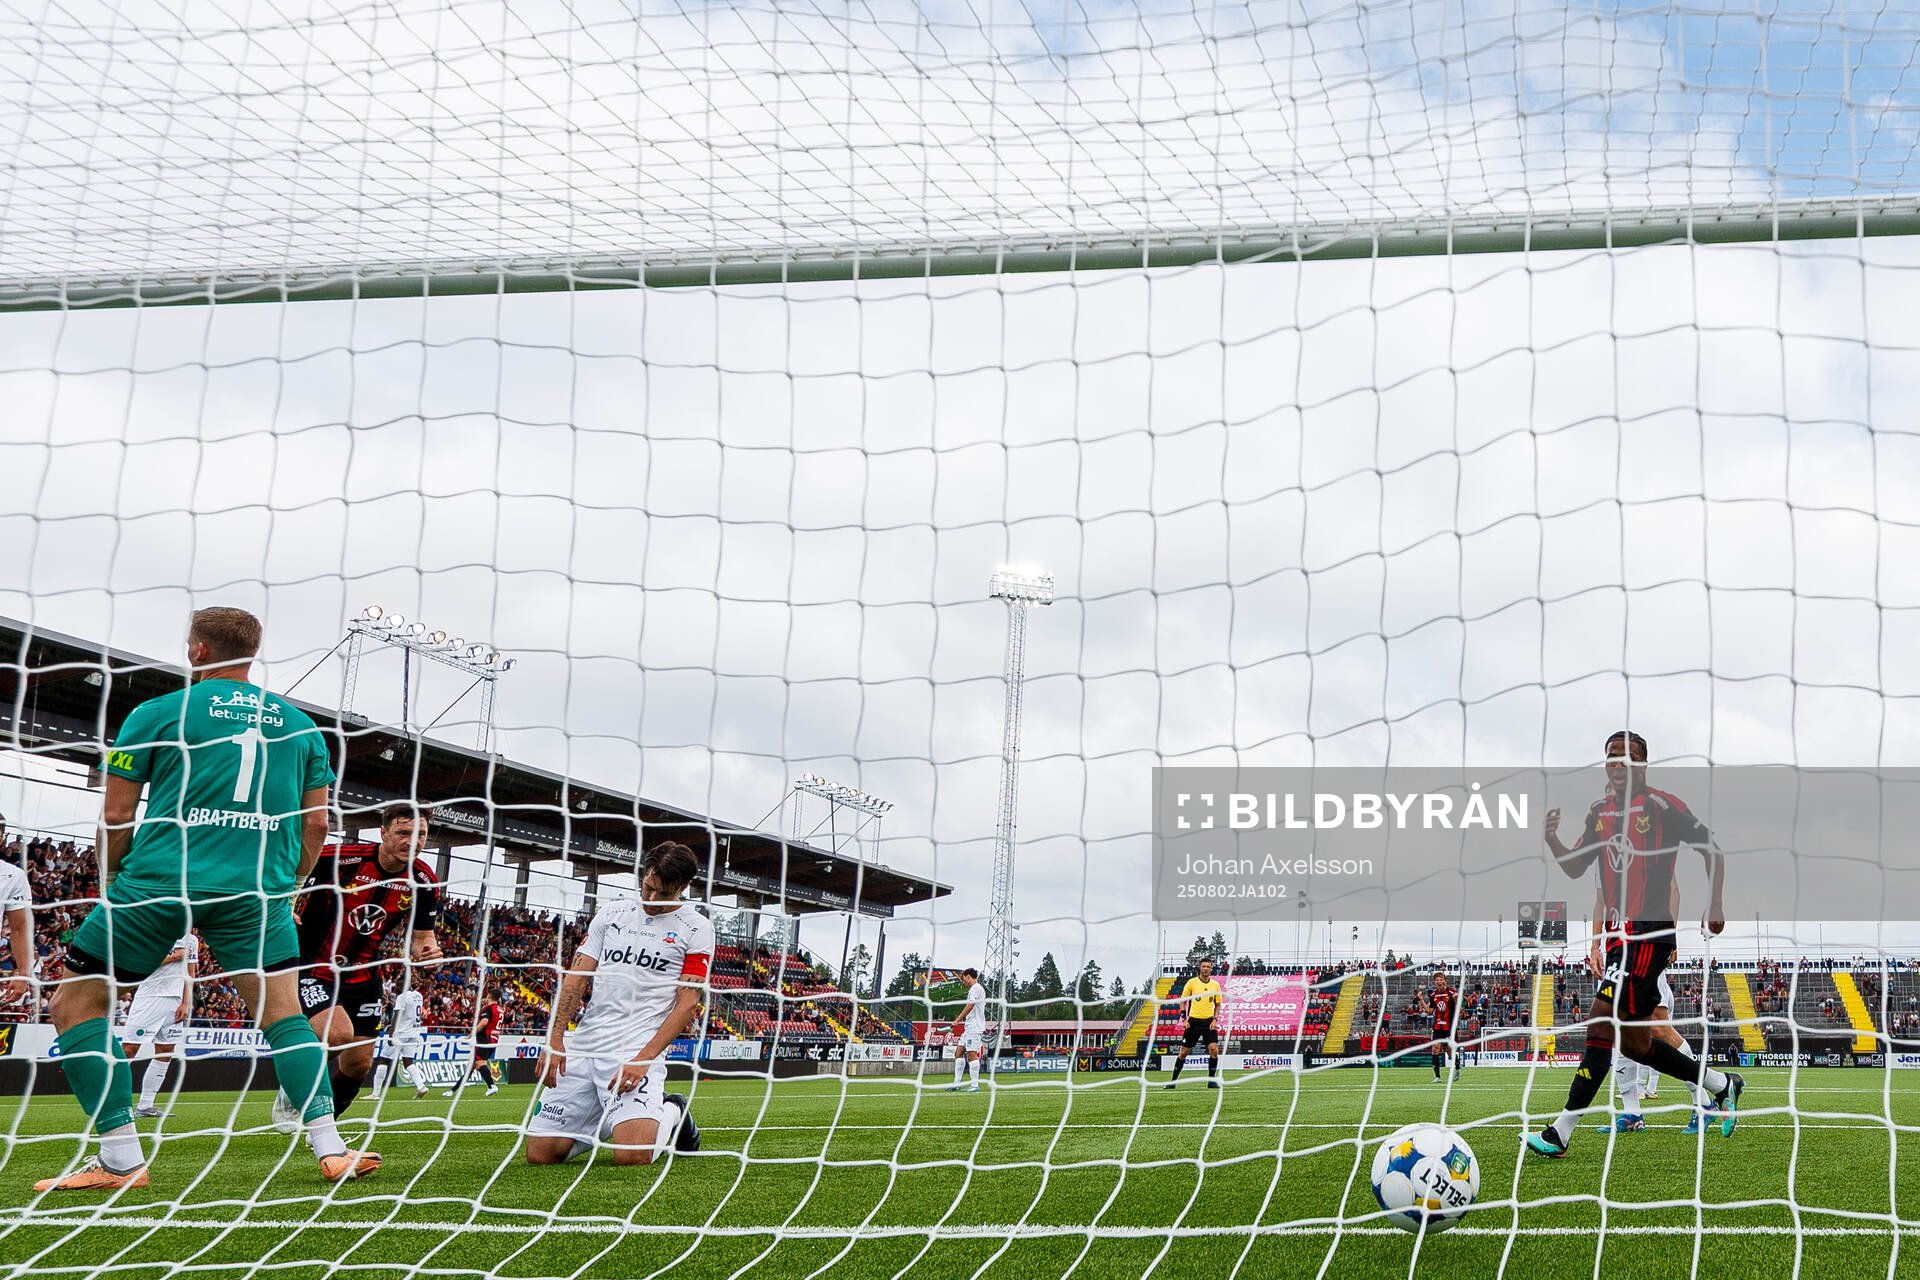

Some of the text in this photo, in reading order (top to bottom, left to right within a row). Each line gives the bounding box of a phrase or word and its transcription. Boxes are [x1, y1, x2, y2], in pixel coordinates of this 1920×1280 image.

[232, 728, 257, 803] 1
[187, 807, 281, 831] BRATTBERG
[989, 1059, 1069, 1070] POLARIS
[542, 1103, 565, 1116] Solid
[1419, 1167, 1468, 1208] SELECT
